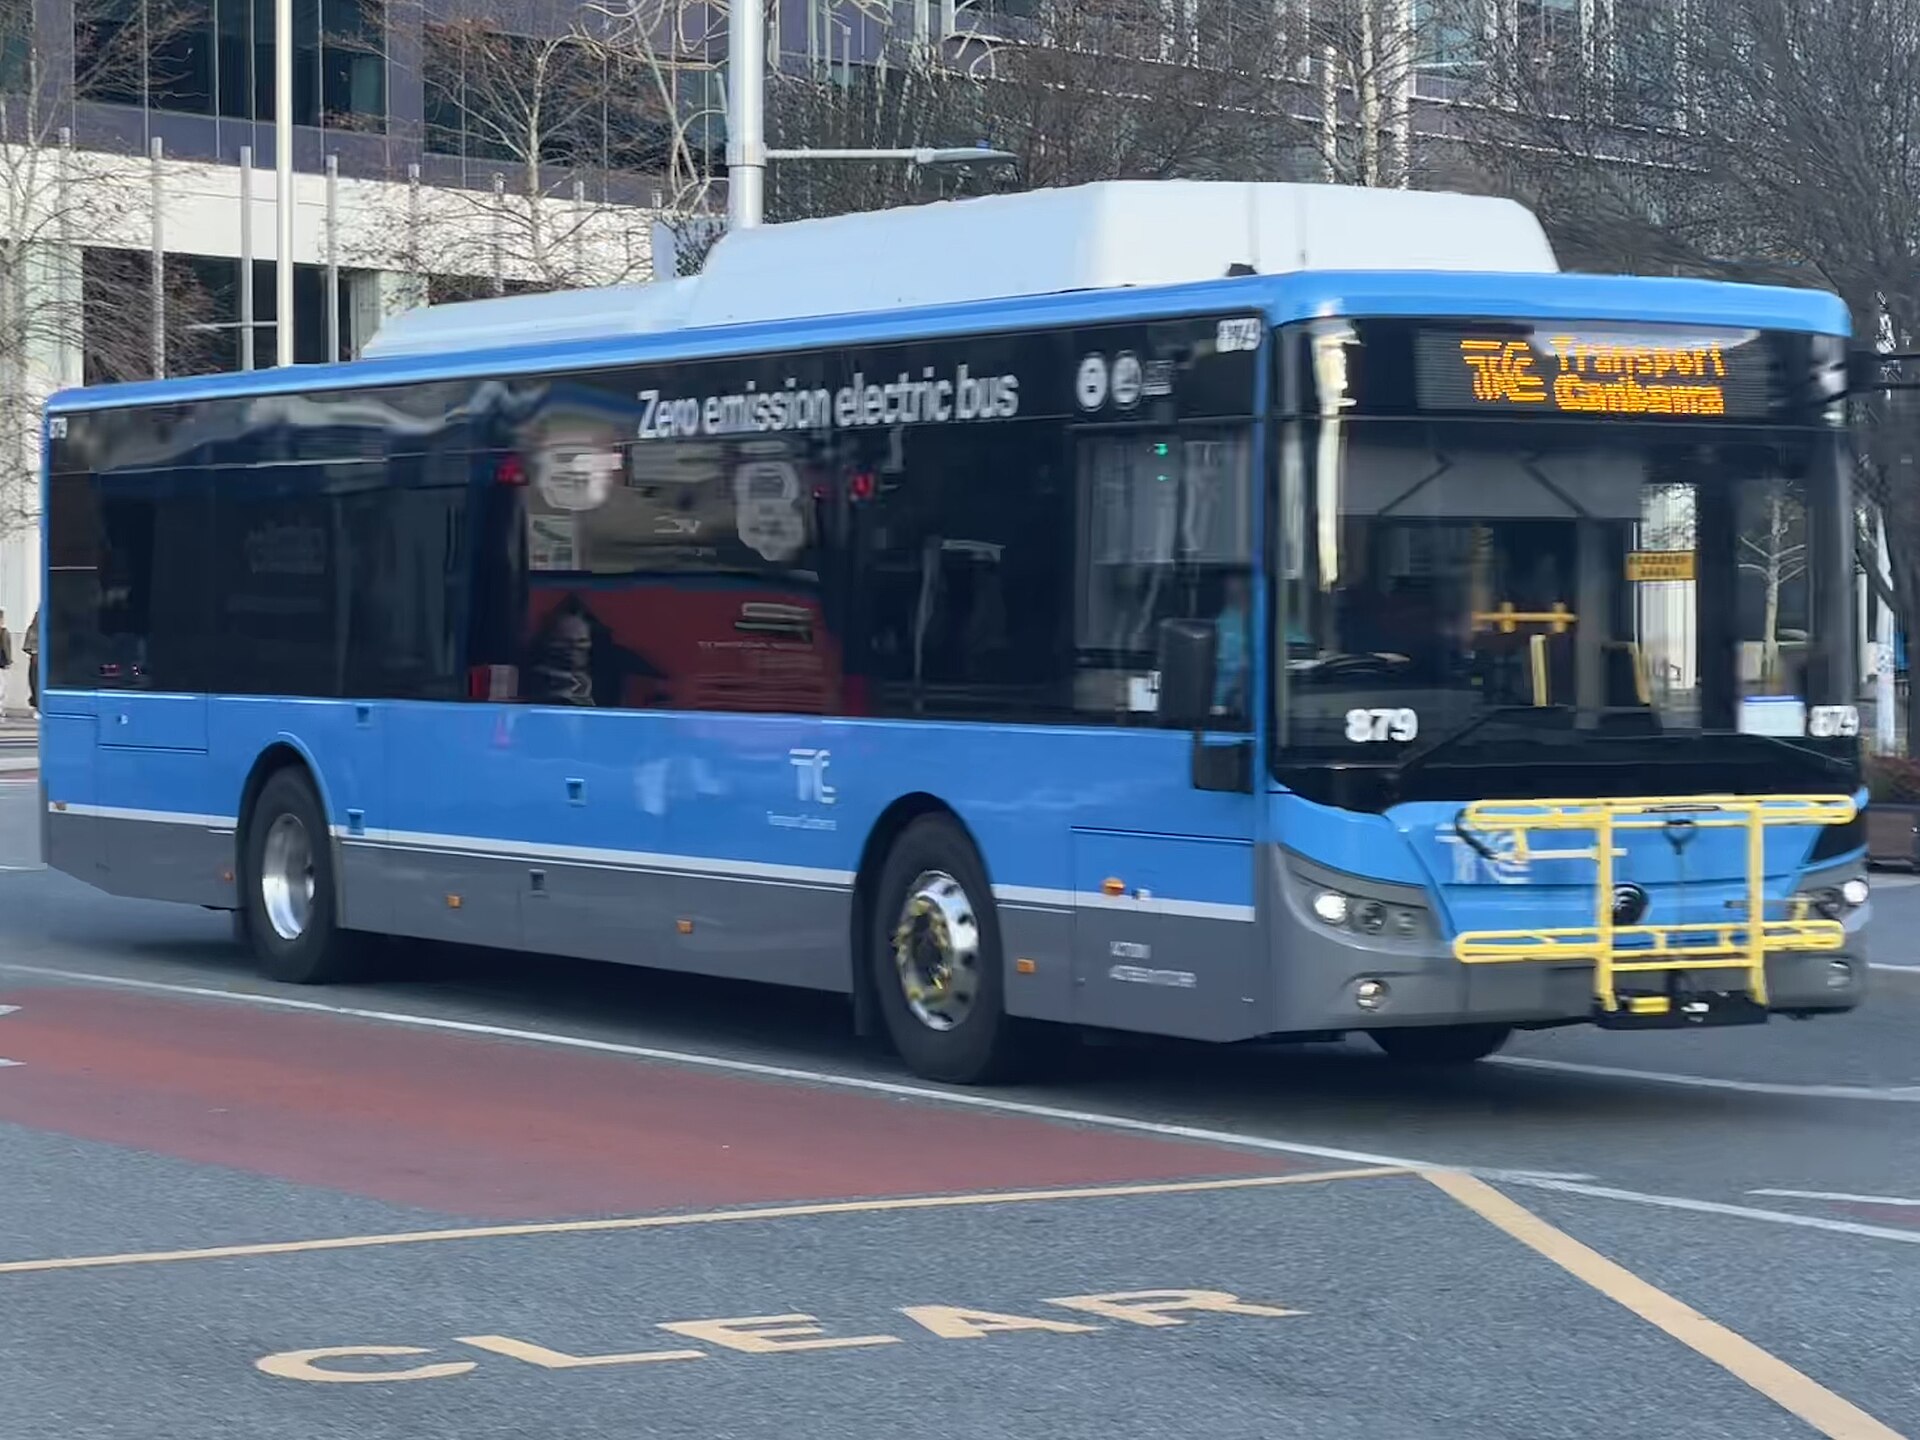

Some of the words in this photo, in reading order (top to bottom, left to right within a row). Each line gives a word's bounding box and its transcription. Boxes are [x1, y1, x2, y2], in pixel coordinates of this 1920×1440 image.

[1549, 335, 1727, 378] Transport
[637, 389, 699, 439] Zero
[703, 377, 831, 435] emission
[835, 366, 952, 427] electric
[956, 363, 1020, 419] bus
[1344, 707, 1419, 742] 879
[1808, 704, 1859, 738] 879
[254, 1288, 1302, 1383] CLEAR
